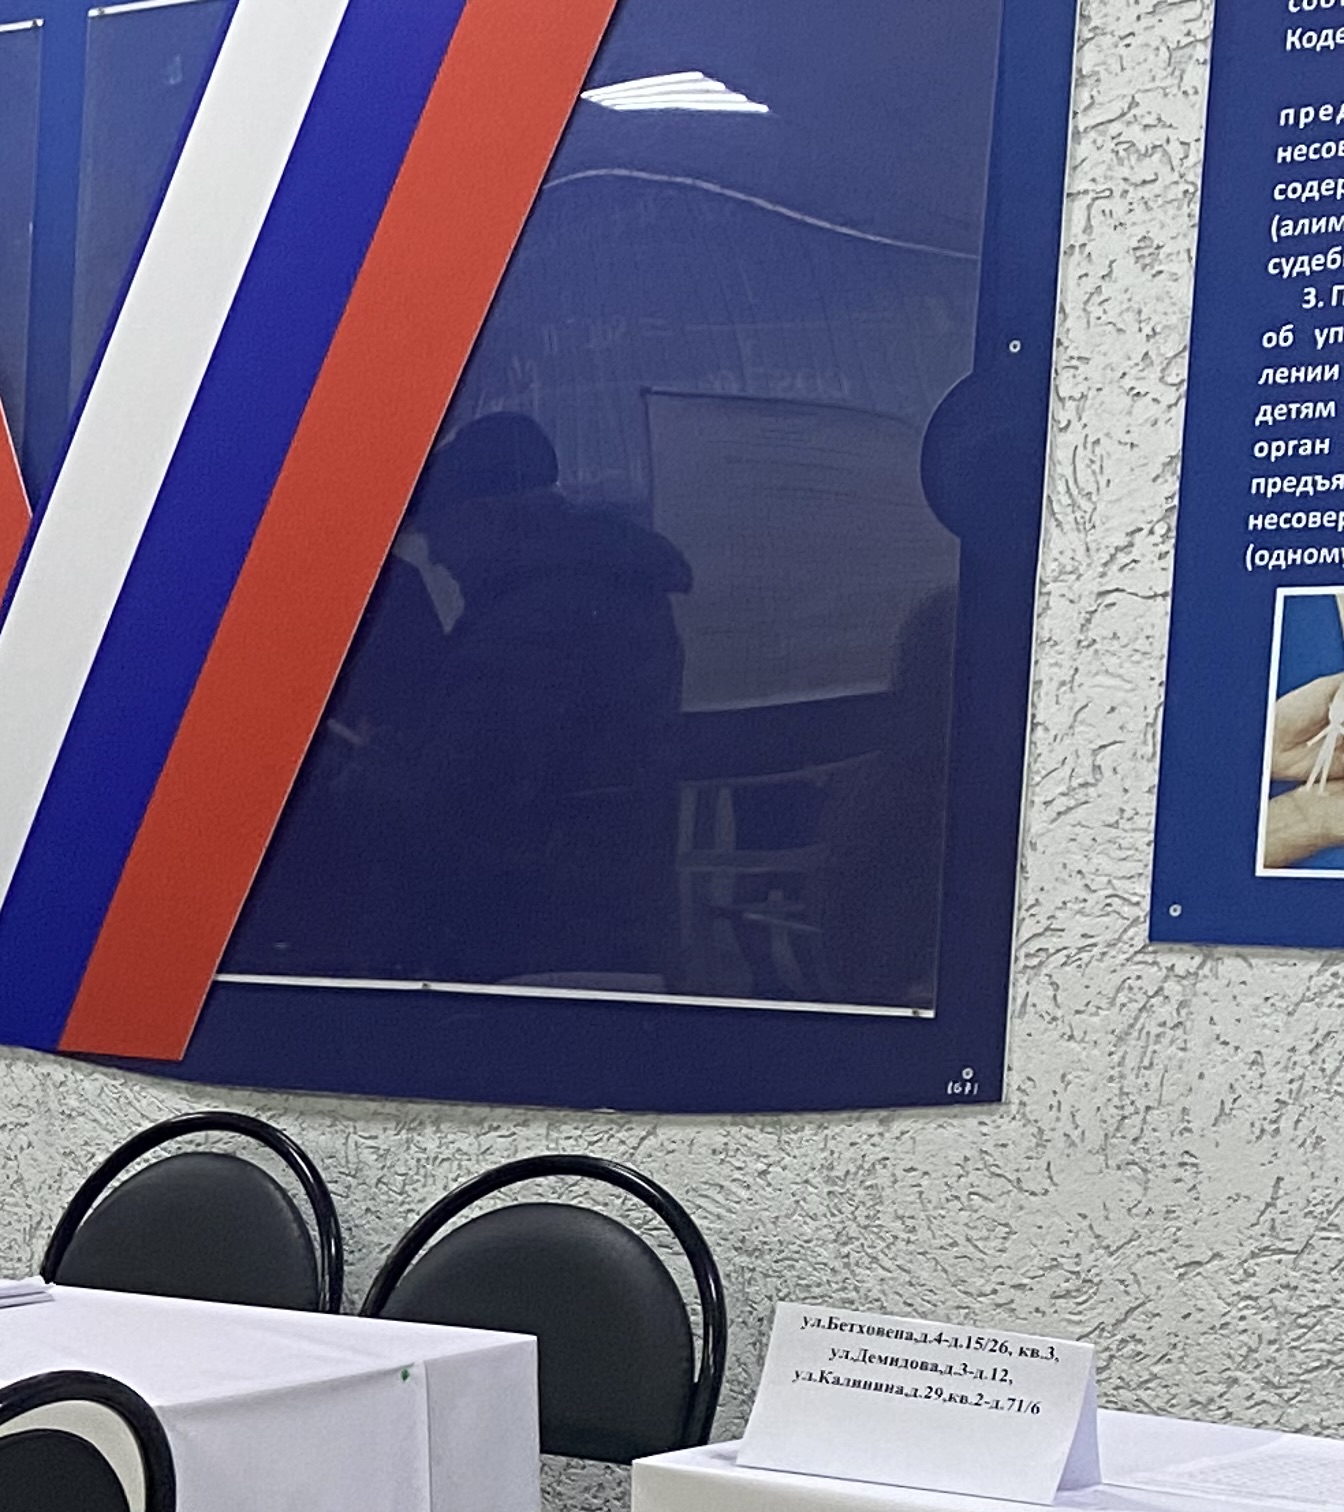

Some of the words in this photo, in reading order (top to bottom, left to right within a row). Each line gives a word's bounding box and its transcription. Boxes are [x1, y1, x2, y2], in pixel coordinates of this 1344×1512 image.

[1267, 245, 1344, 279] судеб
[1302, 286, 1324, 309] 3.
[1262, 323, 1295, 348] об
[1314, 326, 1344, 350] уп
[1257, 364, 1340, 385] лении
[1254, 400, 1336, 427] детям
[1253, 437, 1330, 463] орган
[1250, 473, 1344, 498] предъя
[1245, 543, 1344, 572] (одном
